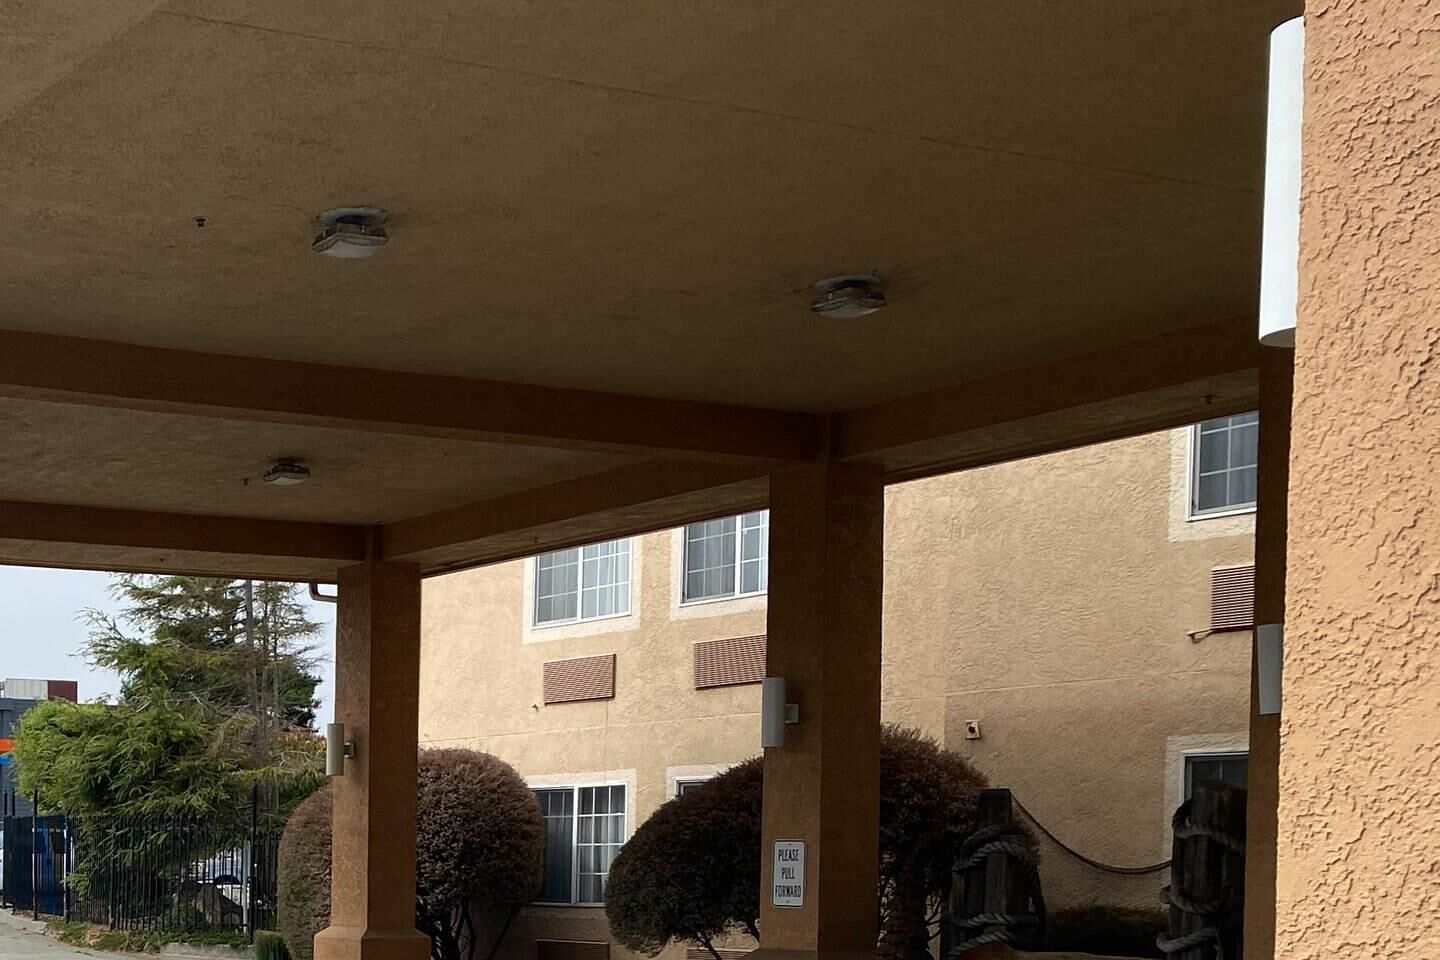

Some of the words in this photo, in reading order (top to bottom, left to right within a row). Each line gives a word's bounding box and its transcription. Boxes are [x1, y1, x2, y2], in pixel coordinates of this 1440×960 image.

[778, 848, 800, 861] PLEASE
[781, 867, 796, 880] PULL
[775, 884, 802, 898] FORWARD
